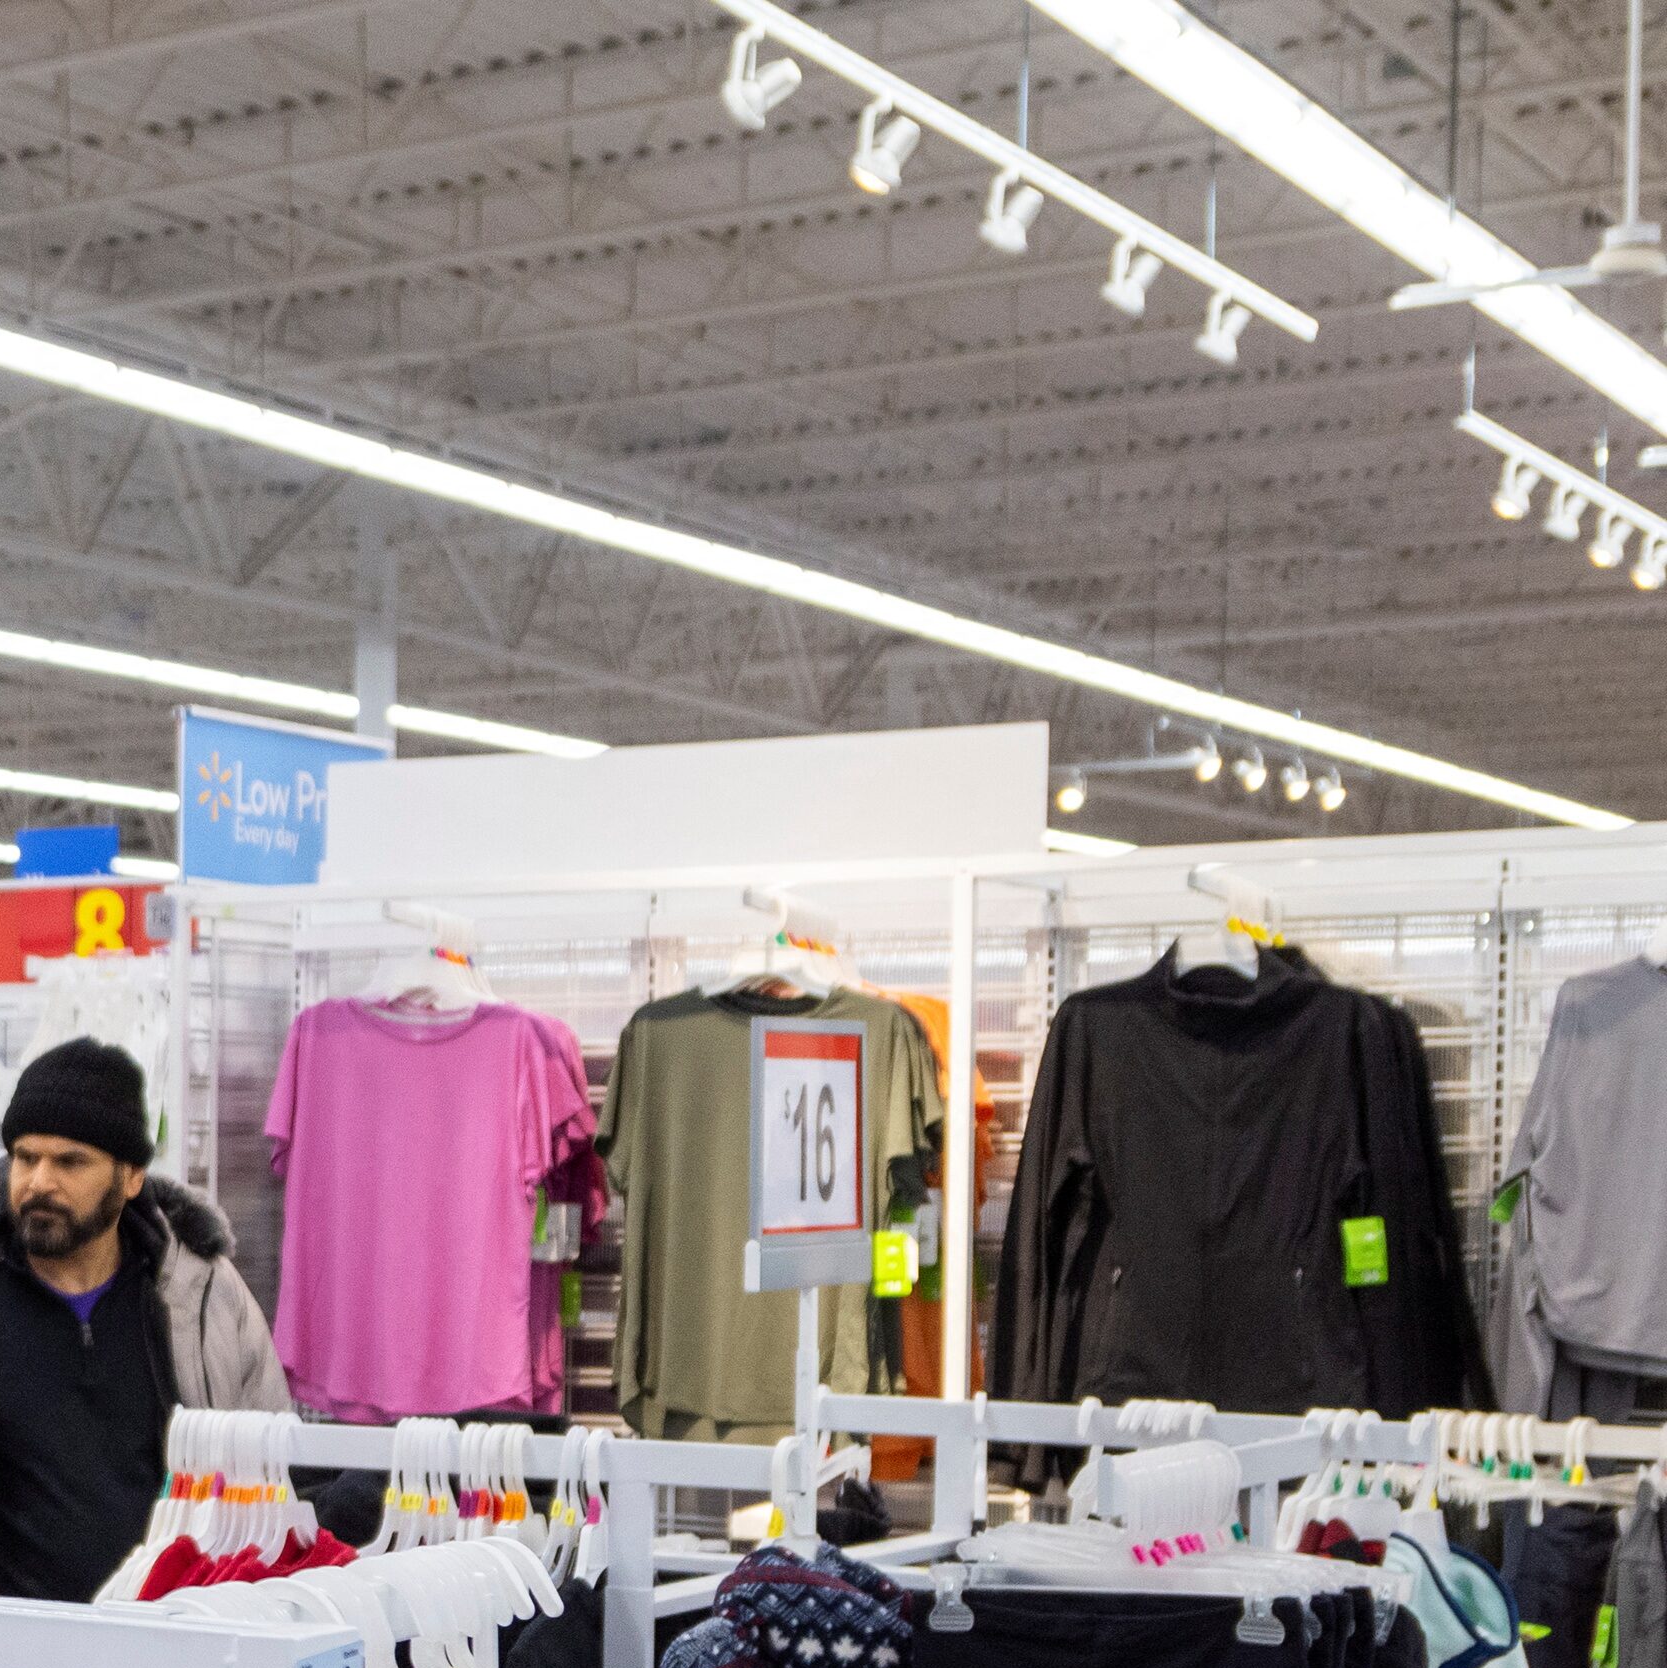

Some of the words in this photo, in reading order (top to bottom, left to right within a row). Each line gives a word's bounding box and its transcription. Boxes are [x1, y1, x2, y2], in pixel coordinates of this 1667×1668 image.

[234, 760, 291, 817] Low
[234, 814, 271, 853] Every
[275, 825, 300, 857] day
